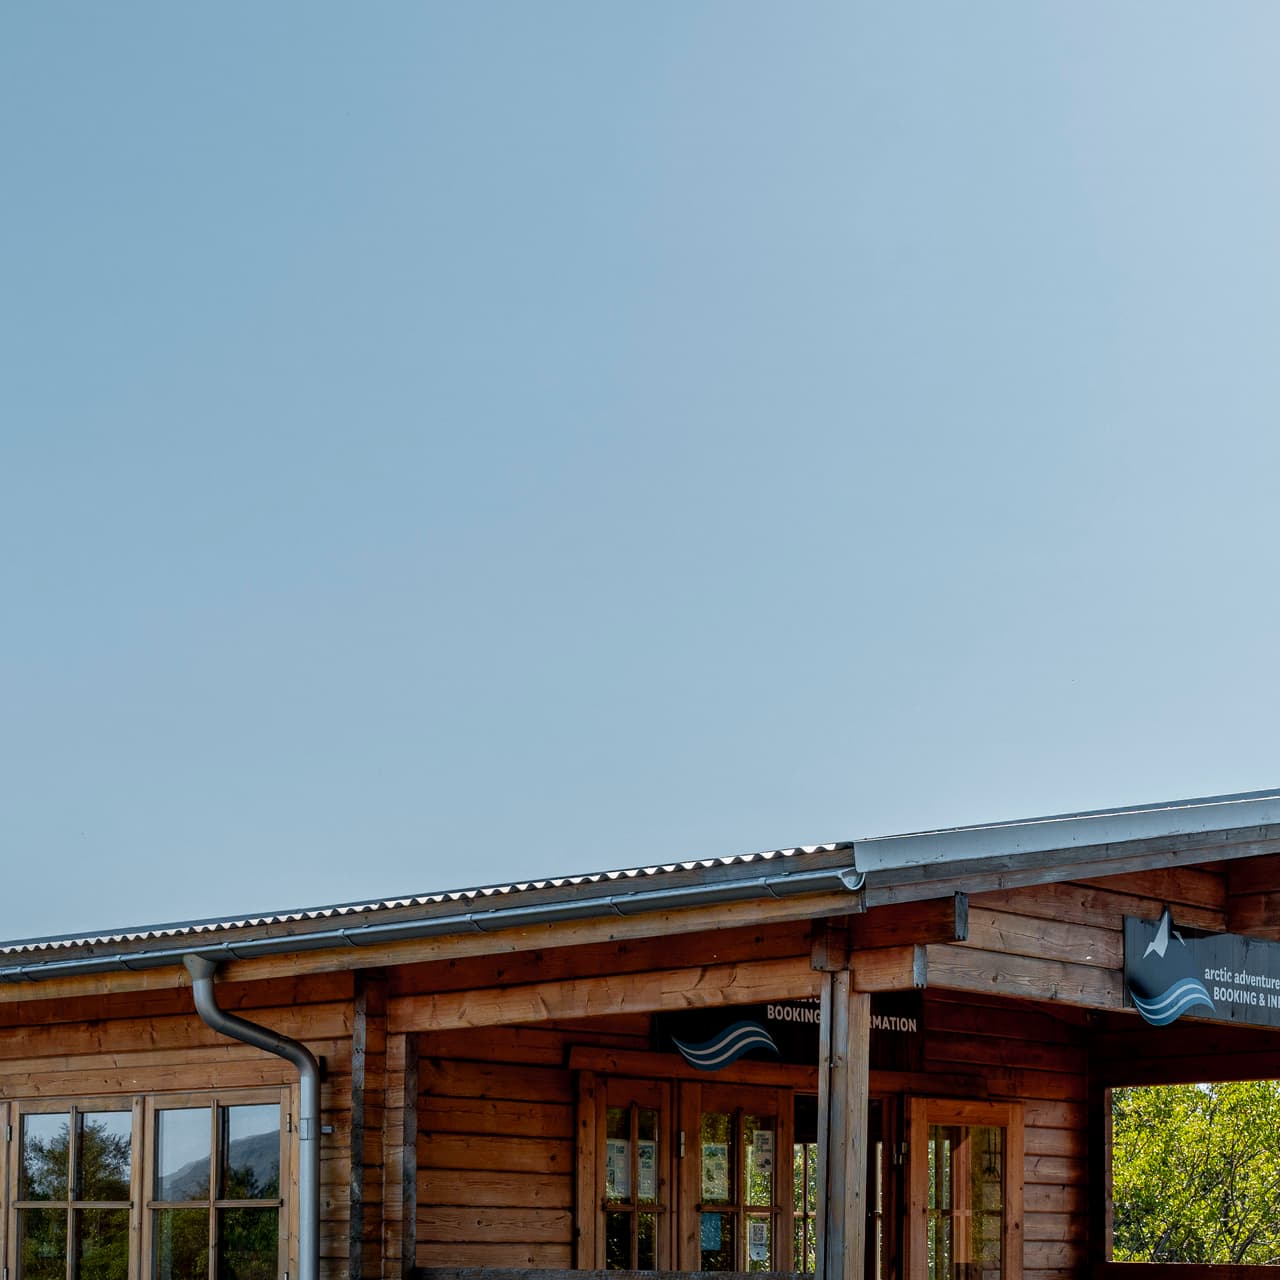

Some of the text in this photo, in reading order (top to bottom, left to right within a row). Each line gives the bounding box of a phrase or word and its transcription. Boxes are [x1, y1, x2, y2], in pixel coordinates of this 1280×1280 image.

[1204, 967, 1232, 982] arctic
[1213, 986, 1257, 1005] BOOKING
[1259, 993, 1266, 1007] &
[767, 1004, 918, 1033] BOOKING MATION
